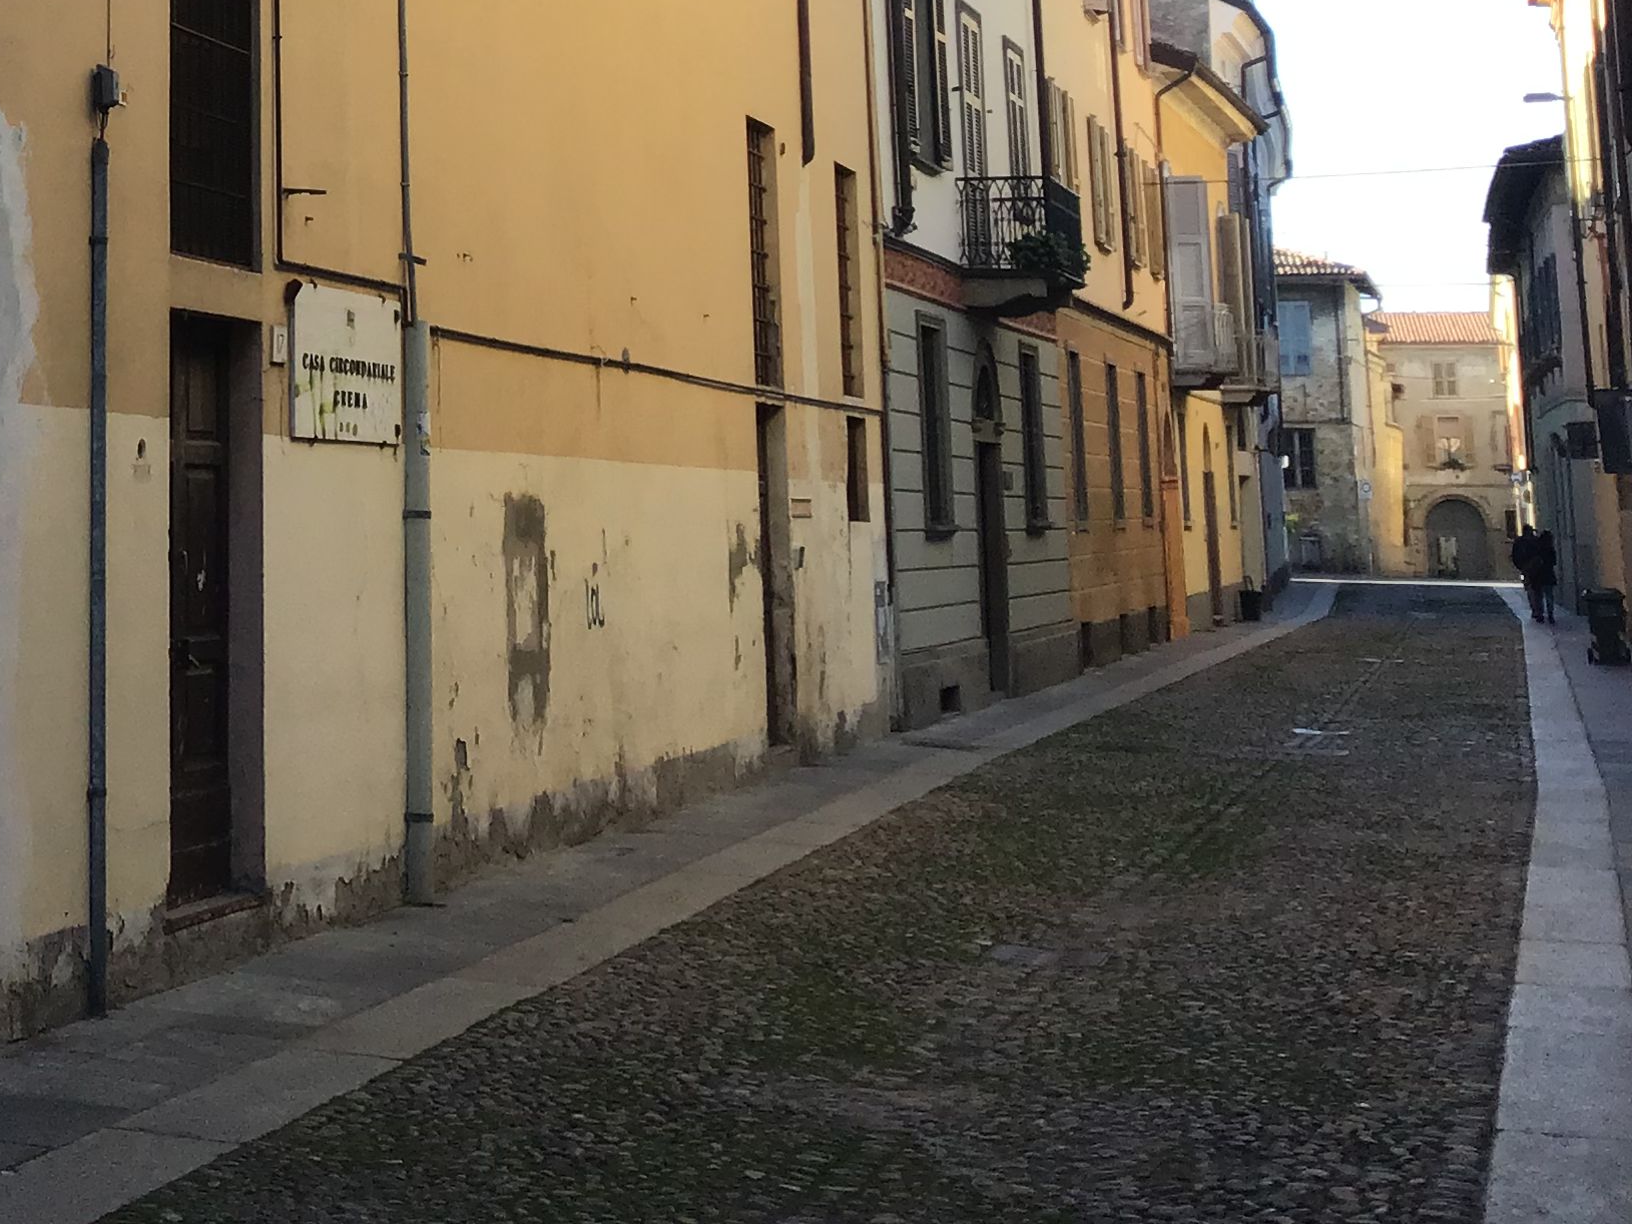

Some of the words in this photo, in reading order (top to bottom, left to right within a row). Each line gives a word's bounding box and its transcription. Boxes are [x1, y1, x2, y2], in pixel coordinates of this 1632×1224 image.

[302, 352, 325, 372] CASA
[329, 356, 396, 382] CIRCONDARIALE
[333, 390, 368, 410] CREMA
